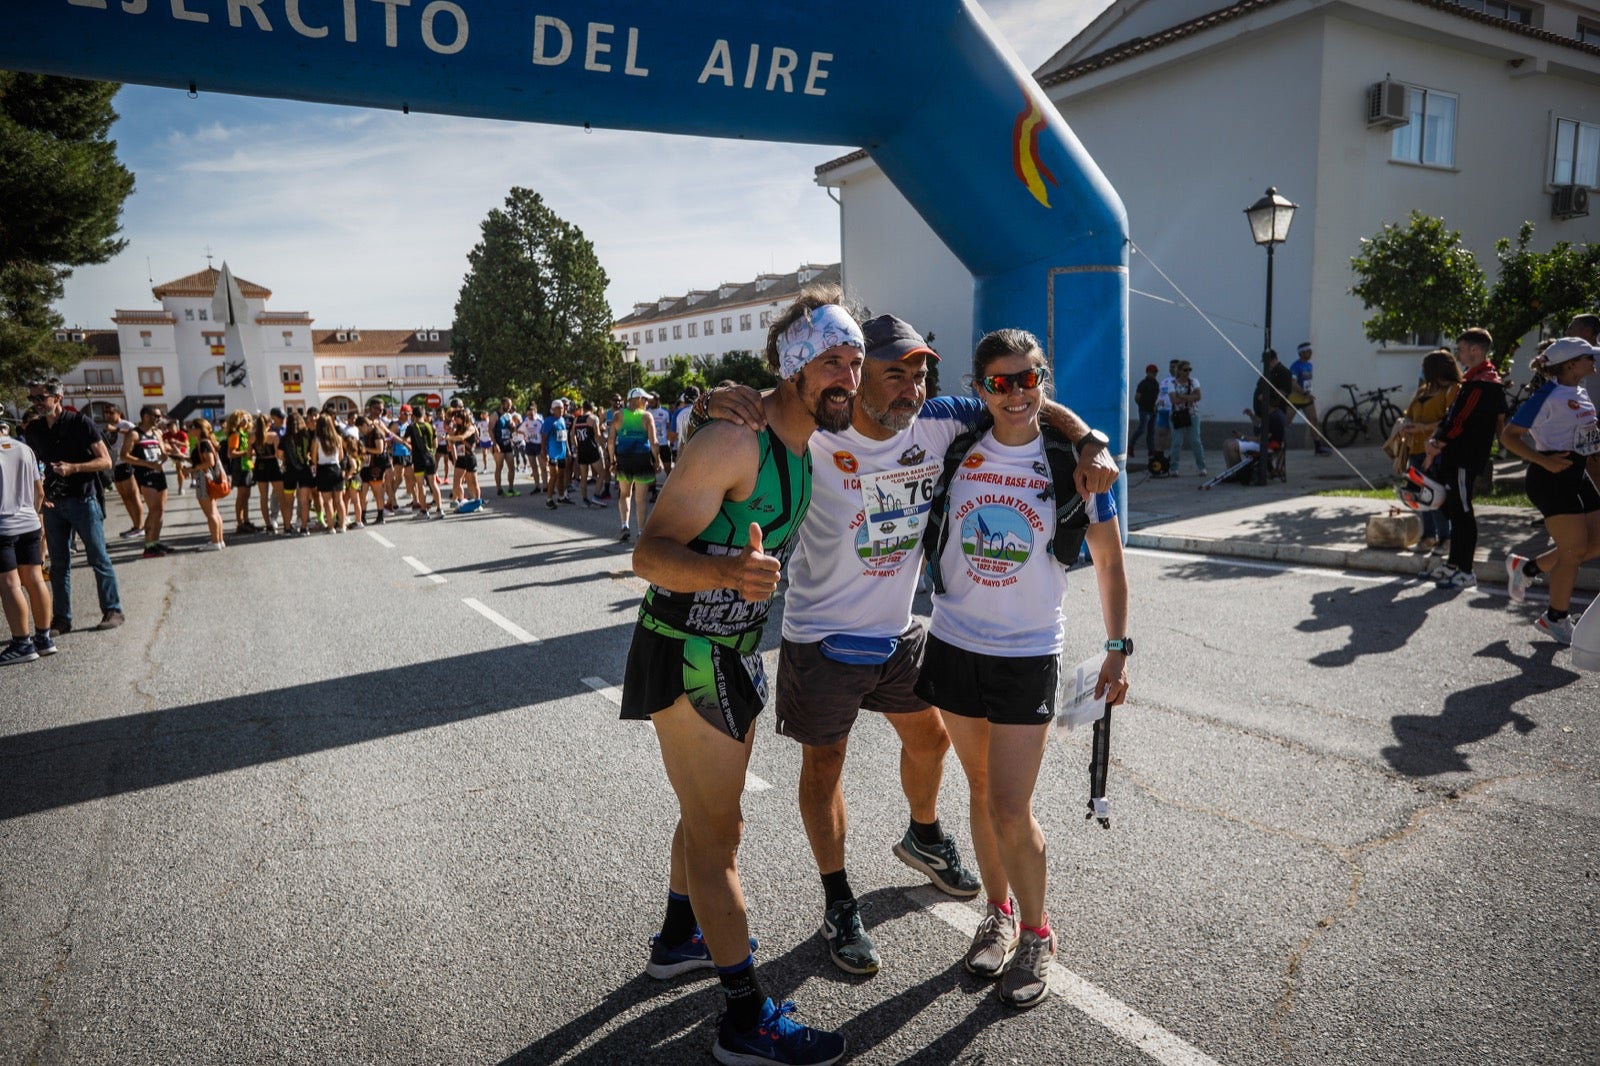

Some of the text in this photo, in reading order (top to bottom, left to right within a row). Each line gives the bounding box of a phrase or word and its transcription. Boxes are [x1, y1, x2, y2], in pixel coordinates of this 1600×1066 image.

[67, 0, 835, 96] RCITO DEL AIRE
[910, 468, 925, 476] BASE
[966, 472, 1003, 485] CARRERA
[1004, 477, 1026, 488] BASE
[843, 479, 850, 490] II
[904, 478, 933, 505] 76
[955, 499, 975, 520] "LOS
[976, 494, 1045, 533] VOLANTONES"
[972, 574, 981, 584] DE
[982, 578, 1001, 588] MAYO
[1002, 575, 1018, 587] 2022
[718, 681, 728, 698] QUE
[722, 698, 731, 708] DE
